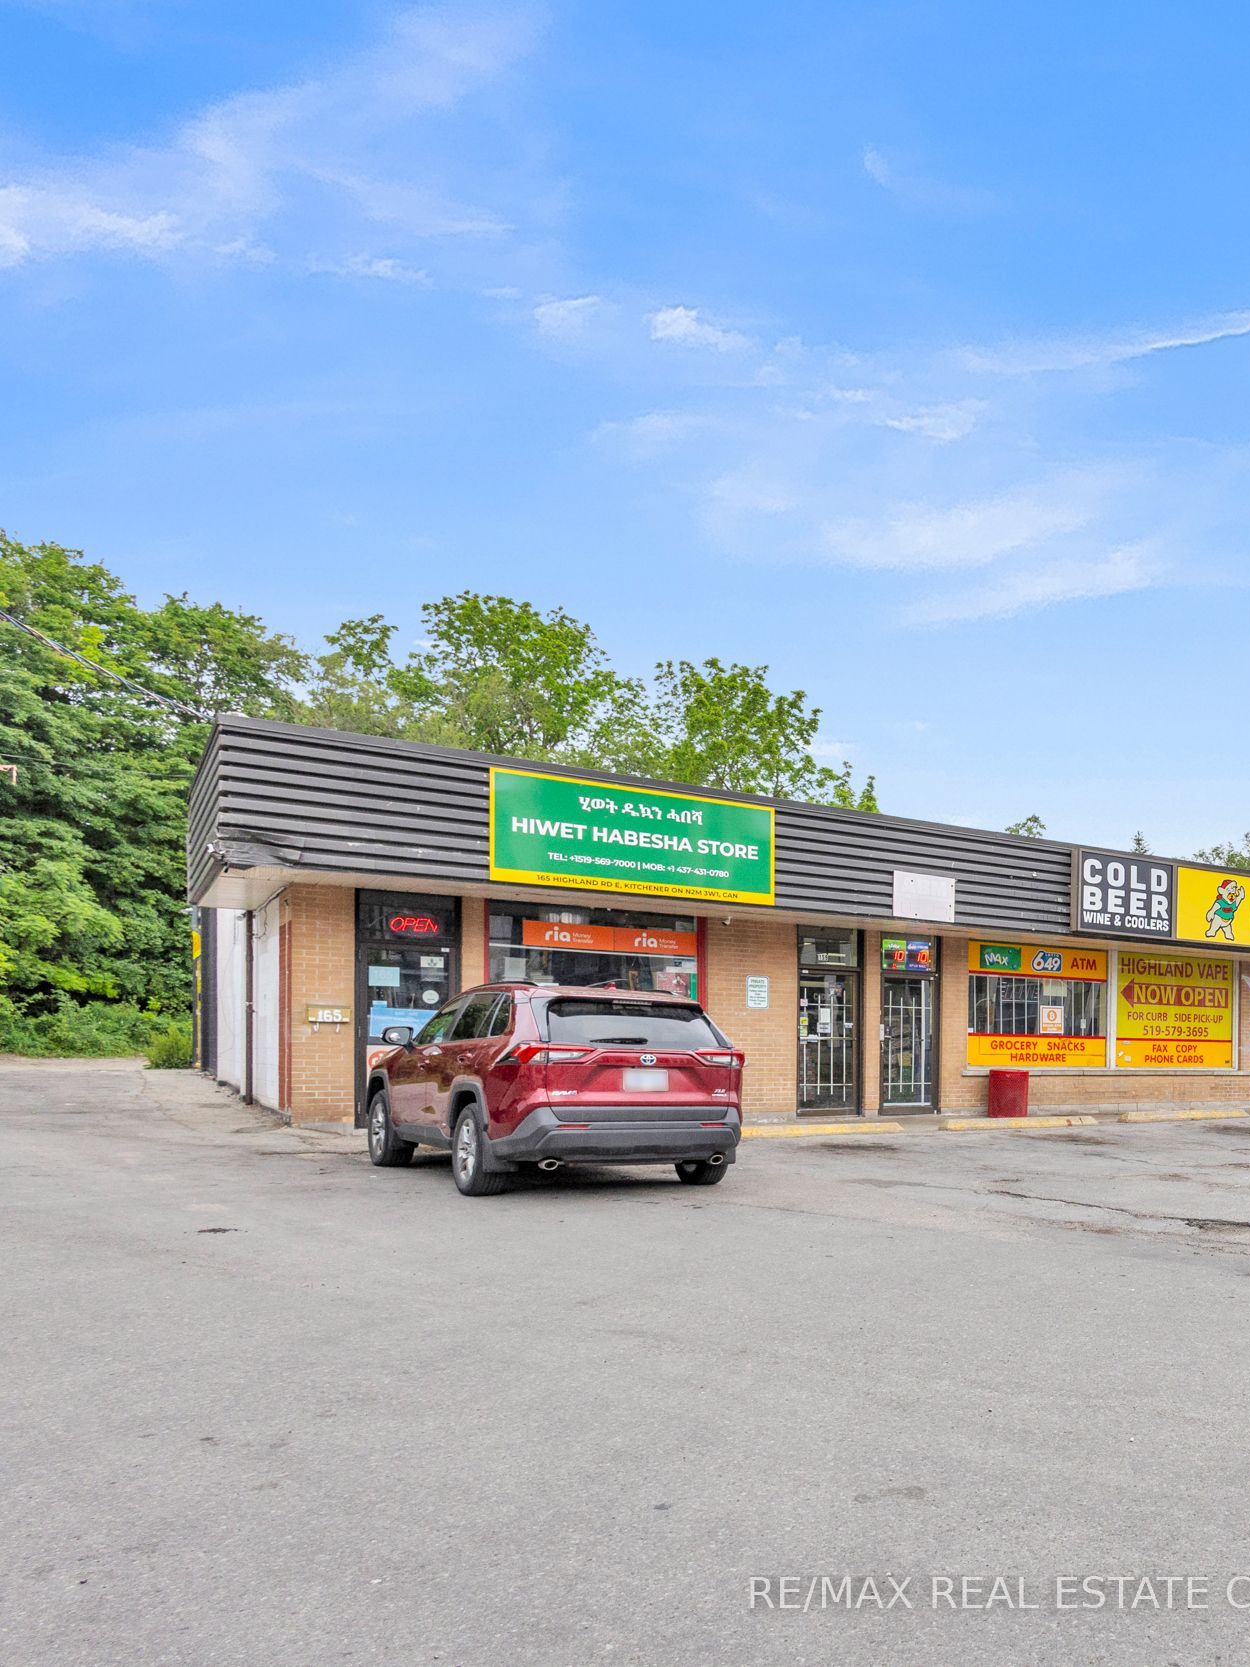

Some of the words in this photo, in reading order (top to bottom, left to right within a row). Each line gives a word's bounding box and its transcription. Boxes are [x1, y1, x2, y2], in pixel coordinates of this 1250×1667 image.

[511, 816, 588, 840] HIWET
[592, 826, 694, 853] HABESHA
[697, 838, 759, 861] STORE
[547, 852, 568, 862] TEL:
[569, 854, 636, 869] +1519-569-7000
[642, 862, 666, 872] MOB:
[676, 866, 730, 878] 437-431-0780
[1083, 858, 1168, 893] COLD
[536, 874, 551, 882] 165
[552, 876, 599, 887] HIGHLAND
[600, 880, 613, 888] RD
[624, 882, 670, 893] KITCHENER
[671, 886, 684, 894] ON
[685, 887, 702, 896] N2M
[722, 891, 739, 899] CAN
[1082, 885, 1169, 919] BEER
[389, 916, 439, 933] OPEN
[1083, 910, 1111, 925] WINE
[1113, 914, 1122, 927] &
[1125, 916, 1170, 932] COOLERS
[544, 926, 571, 943] ria
[634, 932, 658, 948] ria
[1070, 958, 1097, 971] ATM
[1120, 957, 1194, 978] HIGHLAND
[1196, 961, 1229, 981] VAPE
[1133, 983, 1178, 1005] NOW
[1180, 987, 1228, 1008] OPEN
[317, 1010, 342, 1022] 165
[1127, 1010, 1145, 1021] FOR
[1145, 1011, 1168, 1022] CURB
[1173, 1012, 1192, 1023] SIDE
[1193, 1013, 1224, 1024] PICK-UP
[1142, 1026, 1209, 1038] 519-579-3695
[990, 1040, 1038, 1051] GROCERY
[1047, 1041, 1086, 1052] SNACKS
[1152, 1044, 1168, 1053] FAX
[1175, 1044, 1198, 1053] COPY
[1010, 1052, 1067, 1063] HARDWARE
[1144, 1054, 1175, 1064] PHONE
[1176, 1055, 1204, 1064] CARDS
